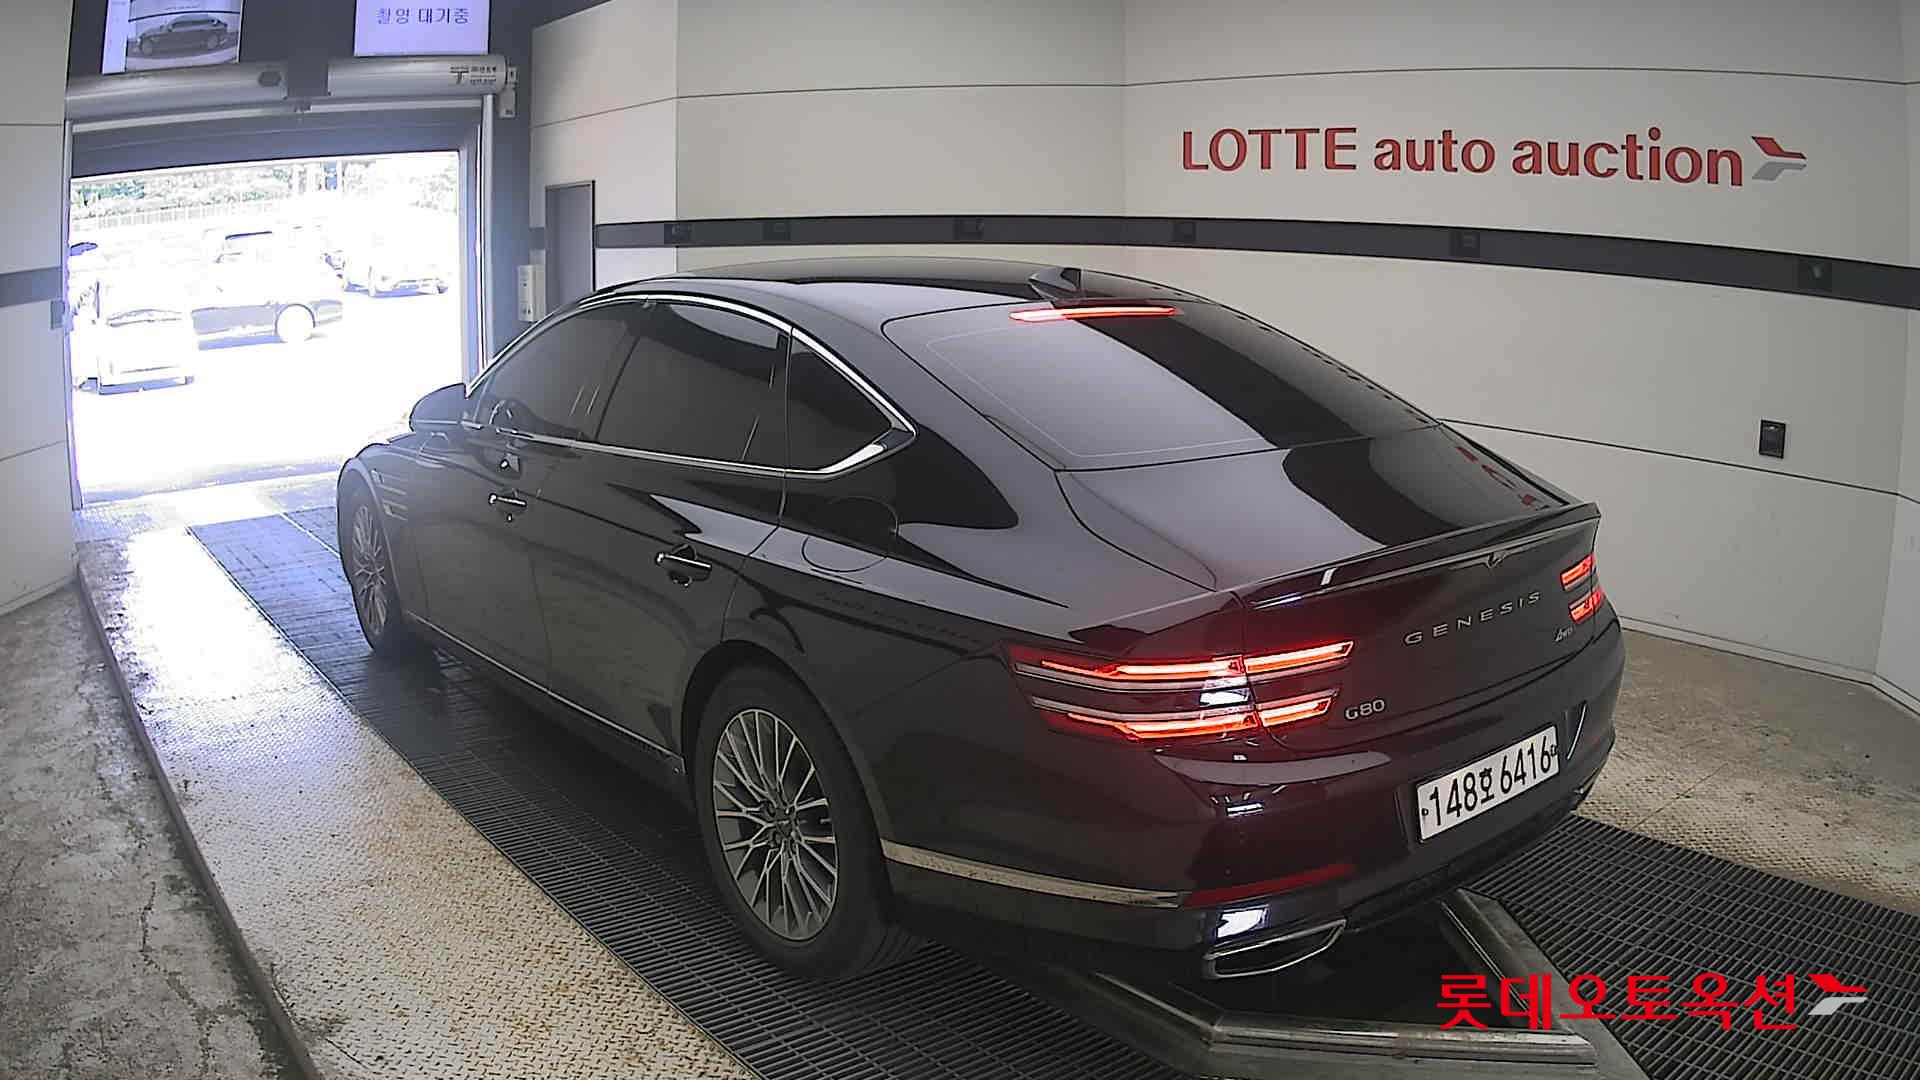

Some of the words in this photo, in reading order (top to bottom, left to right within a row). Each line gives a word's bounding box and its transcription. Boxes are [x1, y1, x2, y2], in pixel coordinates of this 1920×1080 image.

[418, 7, 470, 25] 대기중
[1182, 127, 1357, 171] LOTTE
[1374, 129, 1495, 174] auto
[1512, 127, 1744, 187] auction
[1404, 591, 1541, 645] GENESIS
[1345, 699, 1386, 720] G80
